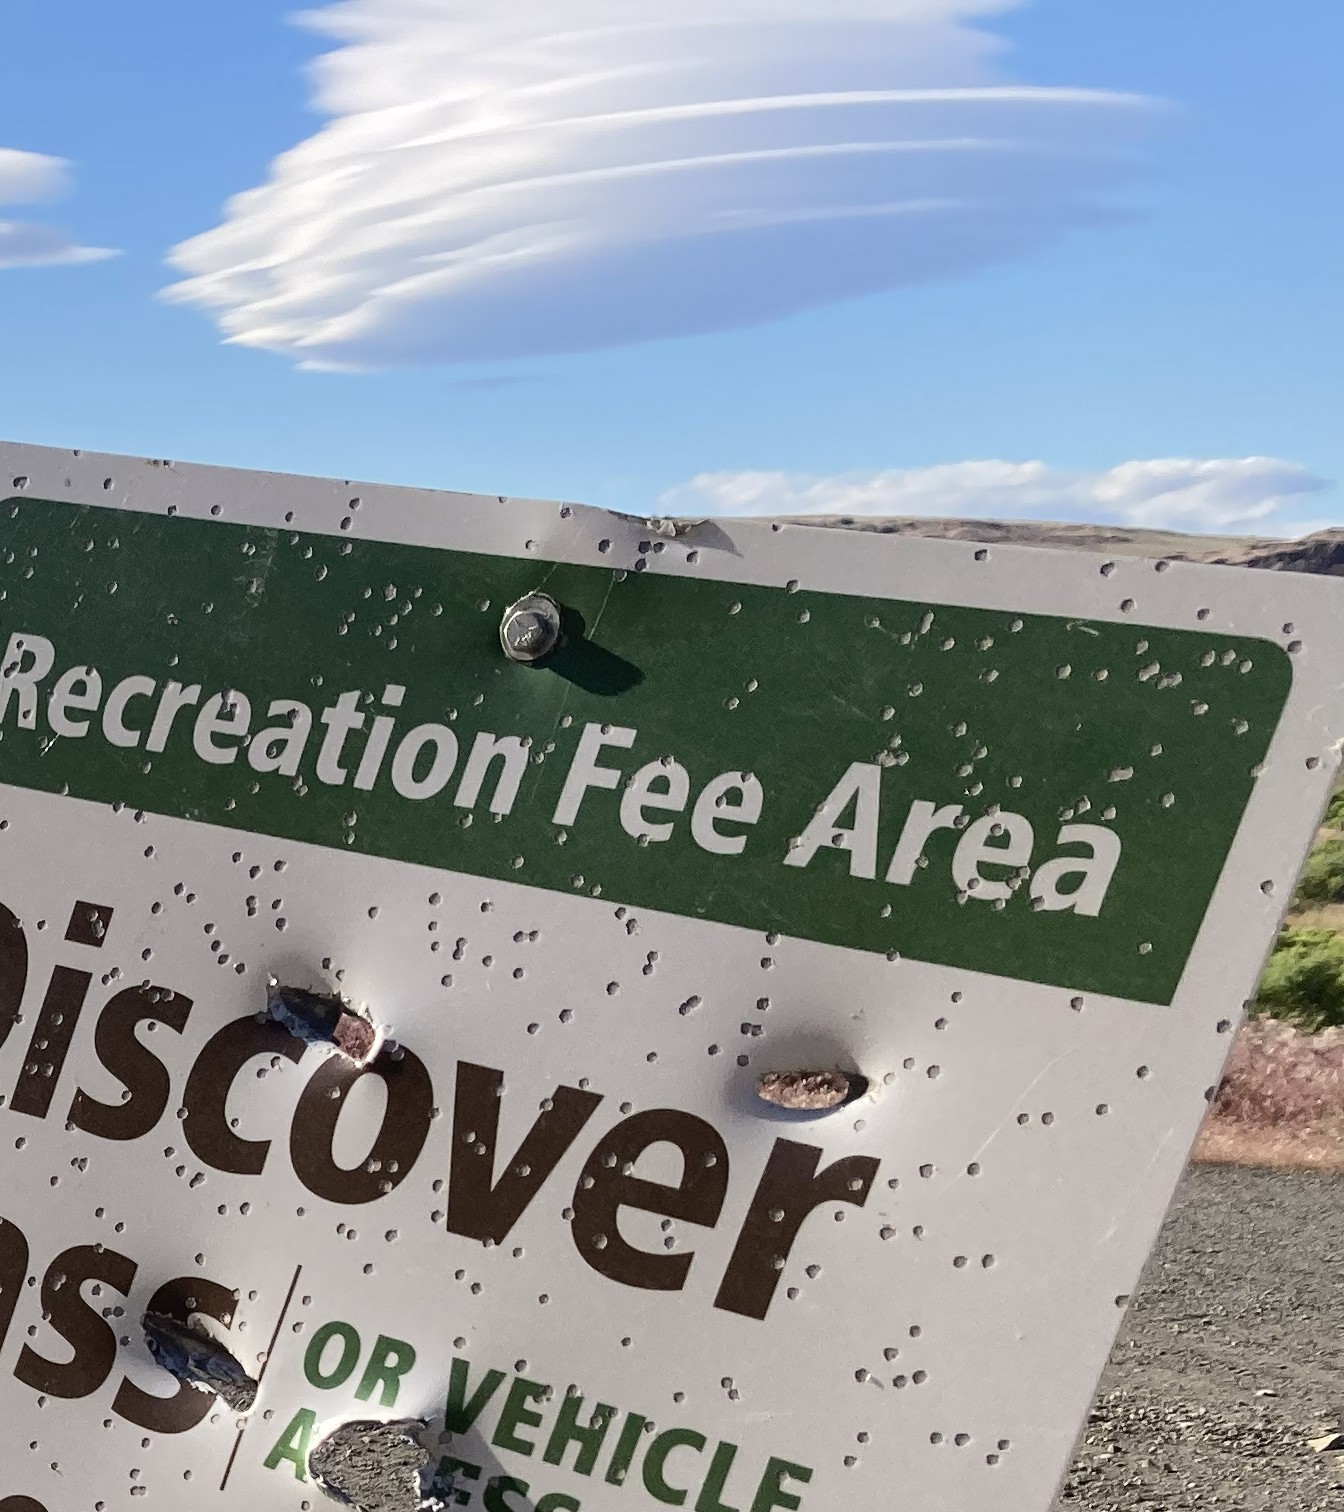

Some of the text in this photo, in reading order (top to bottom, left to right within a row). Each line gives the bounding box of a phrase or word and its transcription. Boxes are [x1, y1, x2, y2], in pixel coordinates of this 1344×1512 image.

[551, 720, 765, 854] Fee
[783, 761, 1123, 917] Area
[304, 1321, 416, 1407] OR
